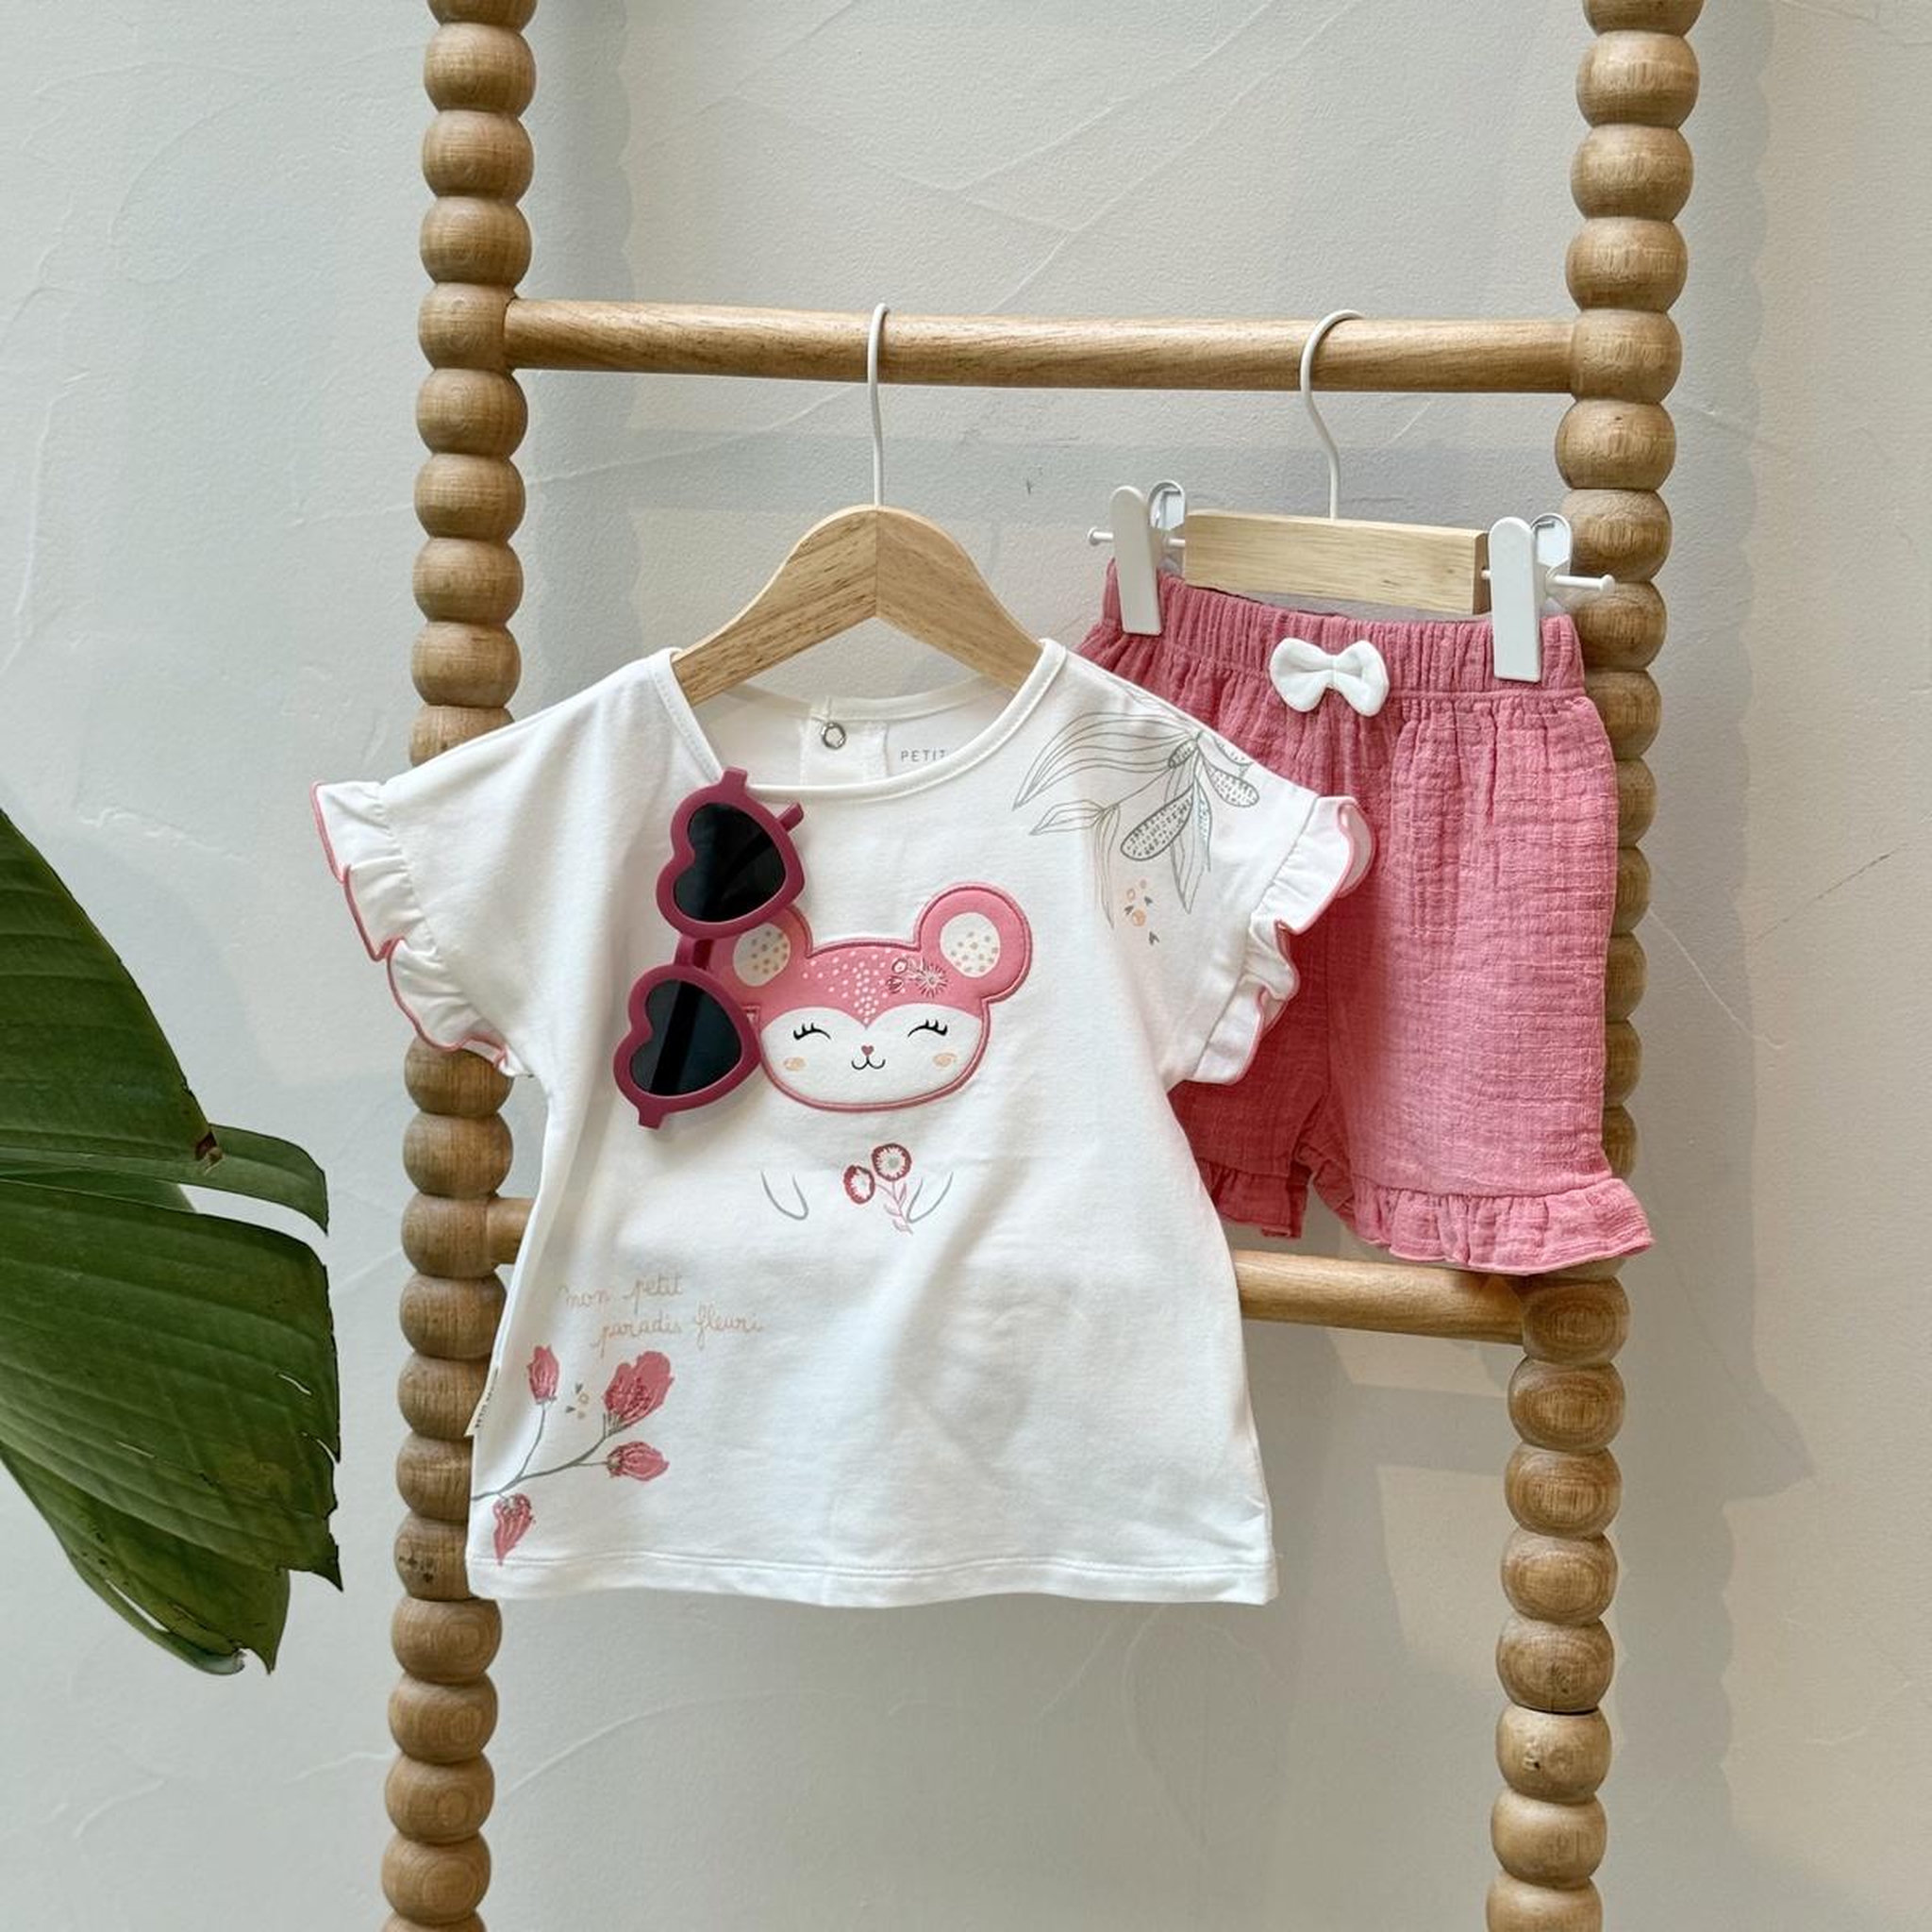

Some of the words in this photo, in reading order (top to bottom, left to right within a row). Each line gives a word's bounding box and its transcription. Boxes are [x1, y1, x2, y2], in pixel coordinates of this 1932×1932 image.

[558, 1284, 612, 1308] mon
[622, 1274, 683, 1314] petit
[590, 1309, 683, 1358] paradis
[693, 1299, 763, 1351] fleuri
